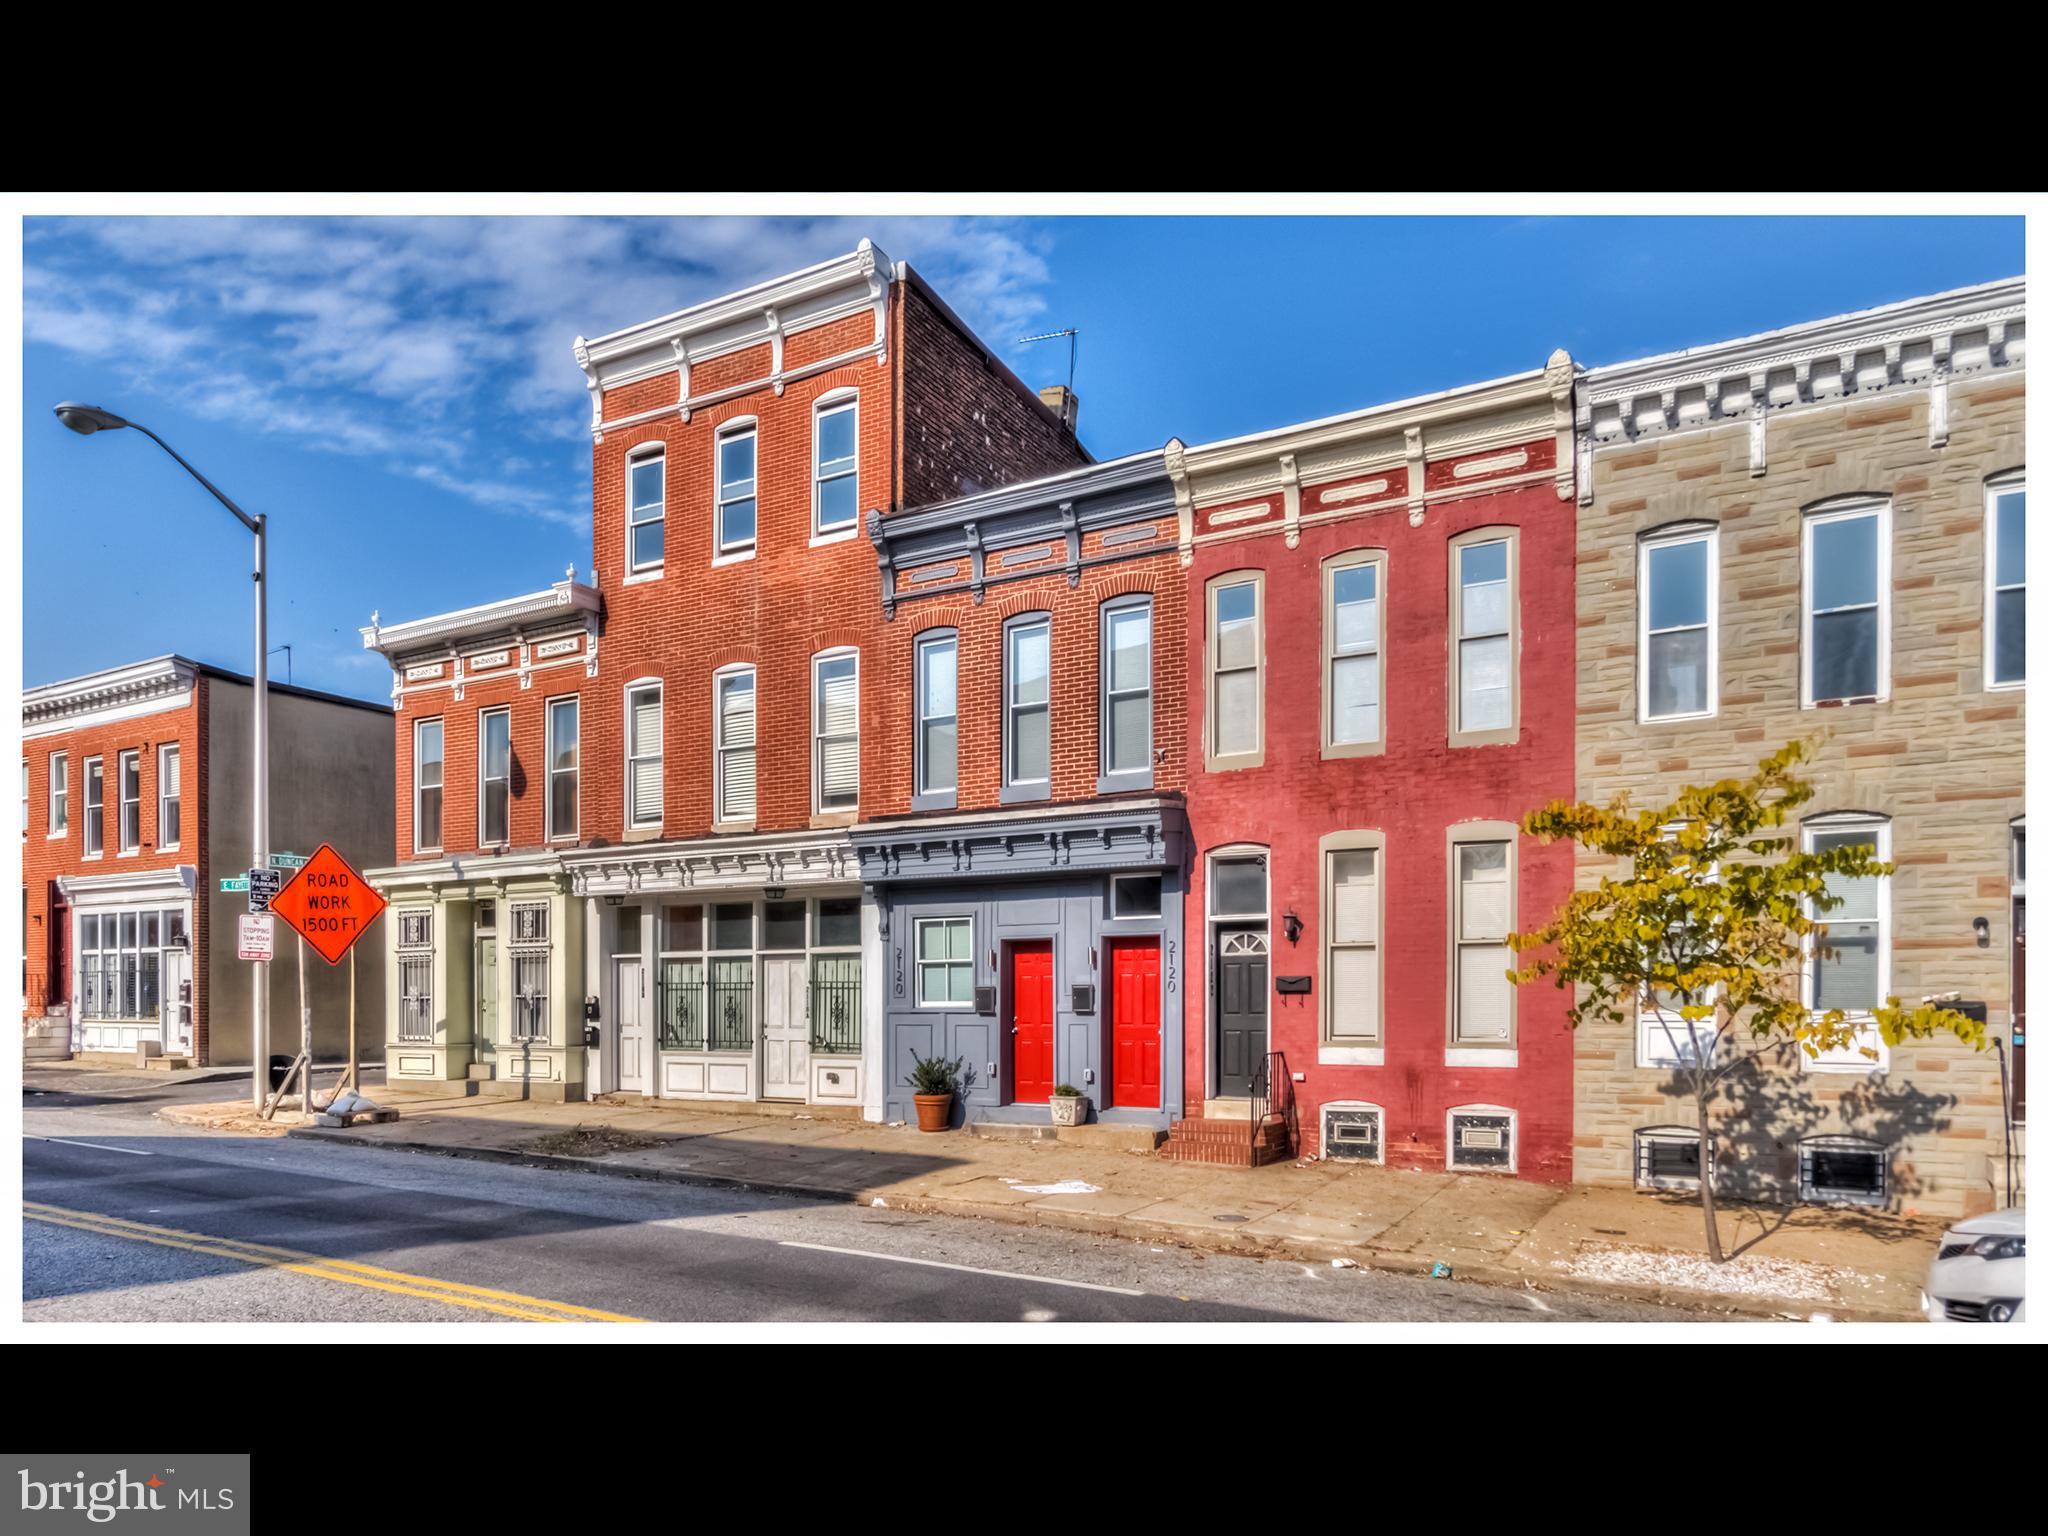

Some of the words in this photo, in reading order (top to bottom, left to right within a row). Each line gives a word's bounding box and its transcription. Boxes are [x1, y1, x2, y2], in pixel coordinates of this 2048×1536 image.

[279, 857, 303, 866] DUNCAN
[307, 873, 349, 887] ROAD
[308, 895, 351, 909] WORK
[302, 917, 338, 932] 1500
[342, 917, 358, 931] FT
[895, 947, 903, 995] 2120
[1167, 940, 1176, 993] 2120
